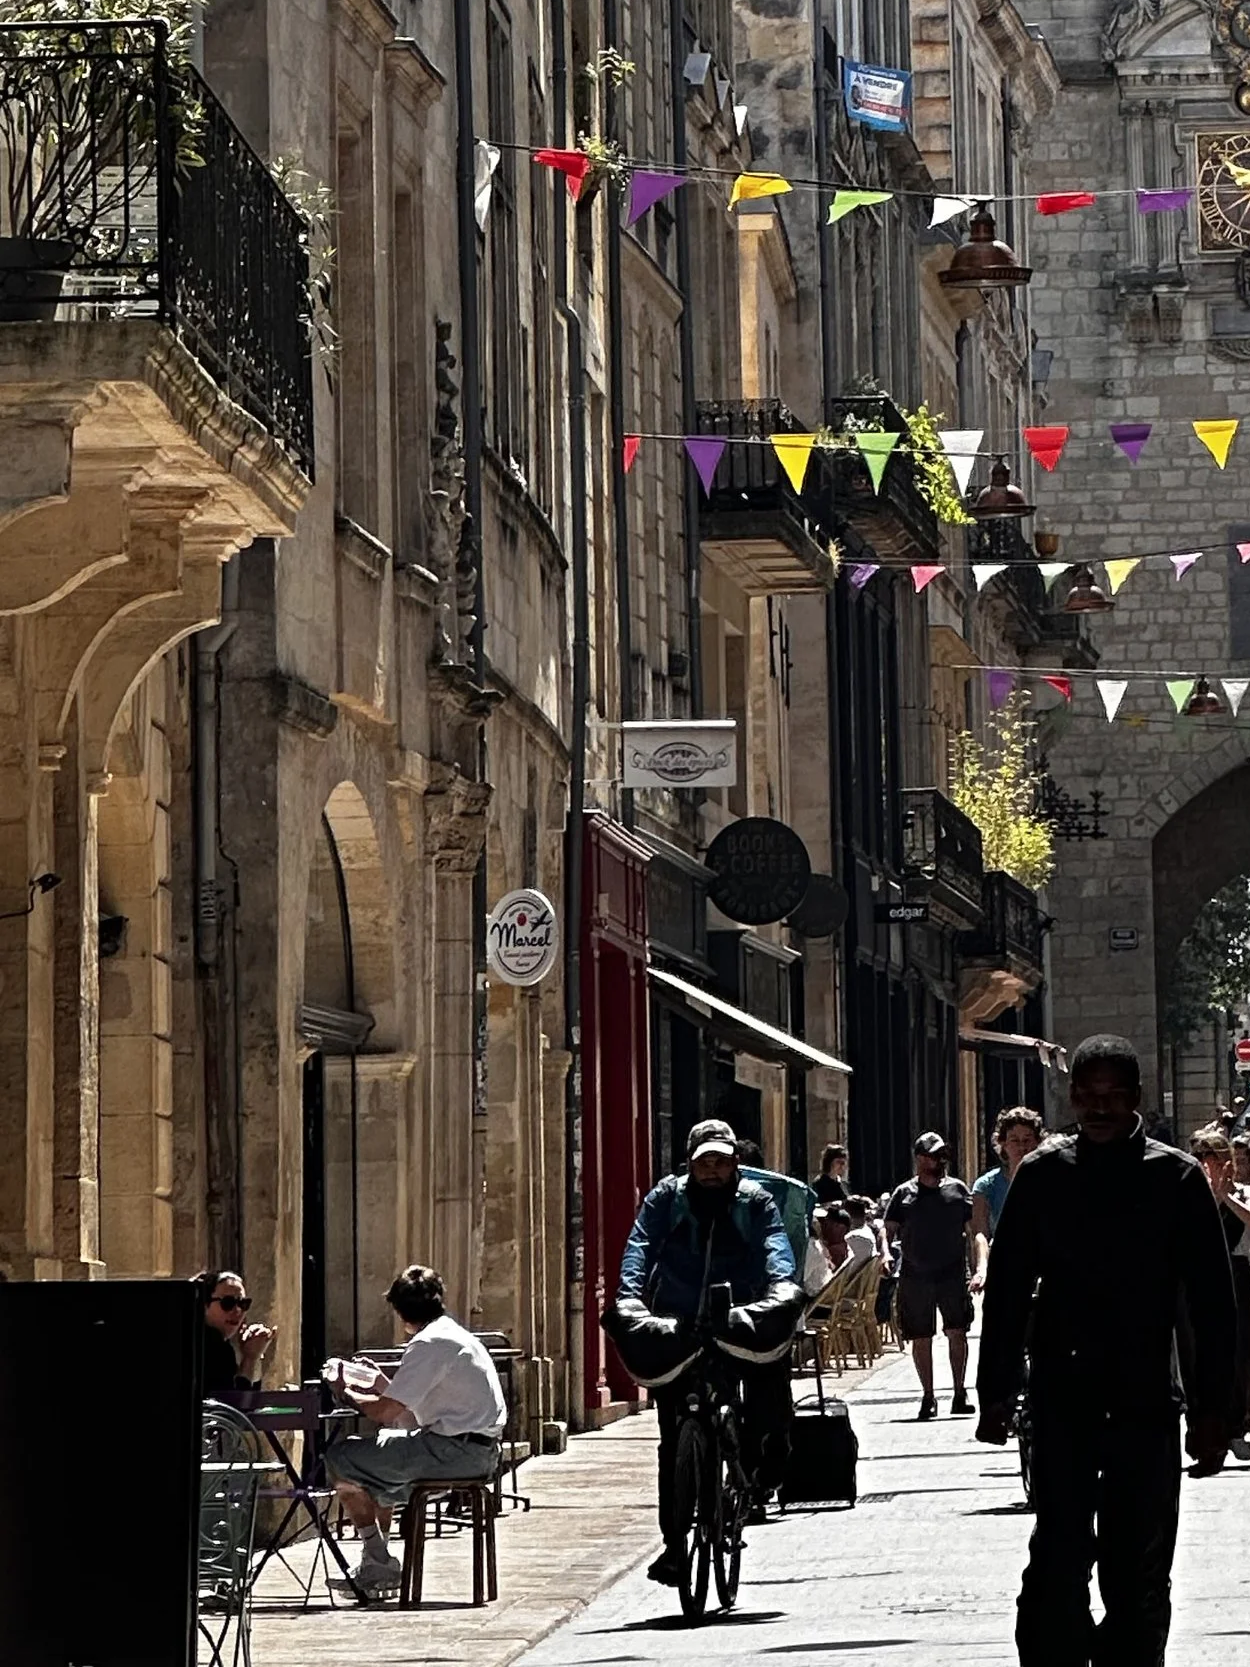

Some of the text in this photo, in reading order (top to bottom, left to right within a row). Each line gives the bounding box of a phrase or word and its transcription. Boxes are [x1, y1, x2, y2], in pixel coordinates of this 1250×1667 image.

[862, 76, 898, 91] VENDRE
[731, 854, 801, 874] COFFEE
[490, 922, 552, 948] Marcel
